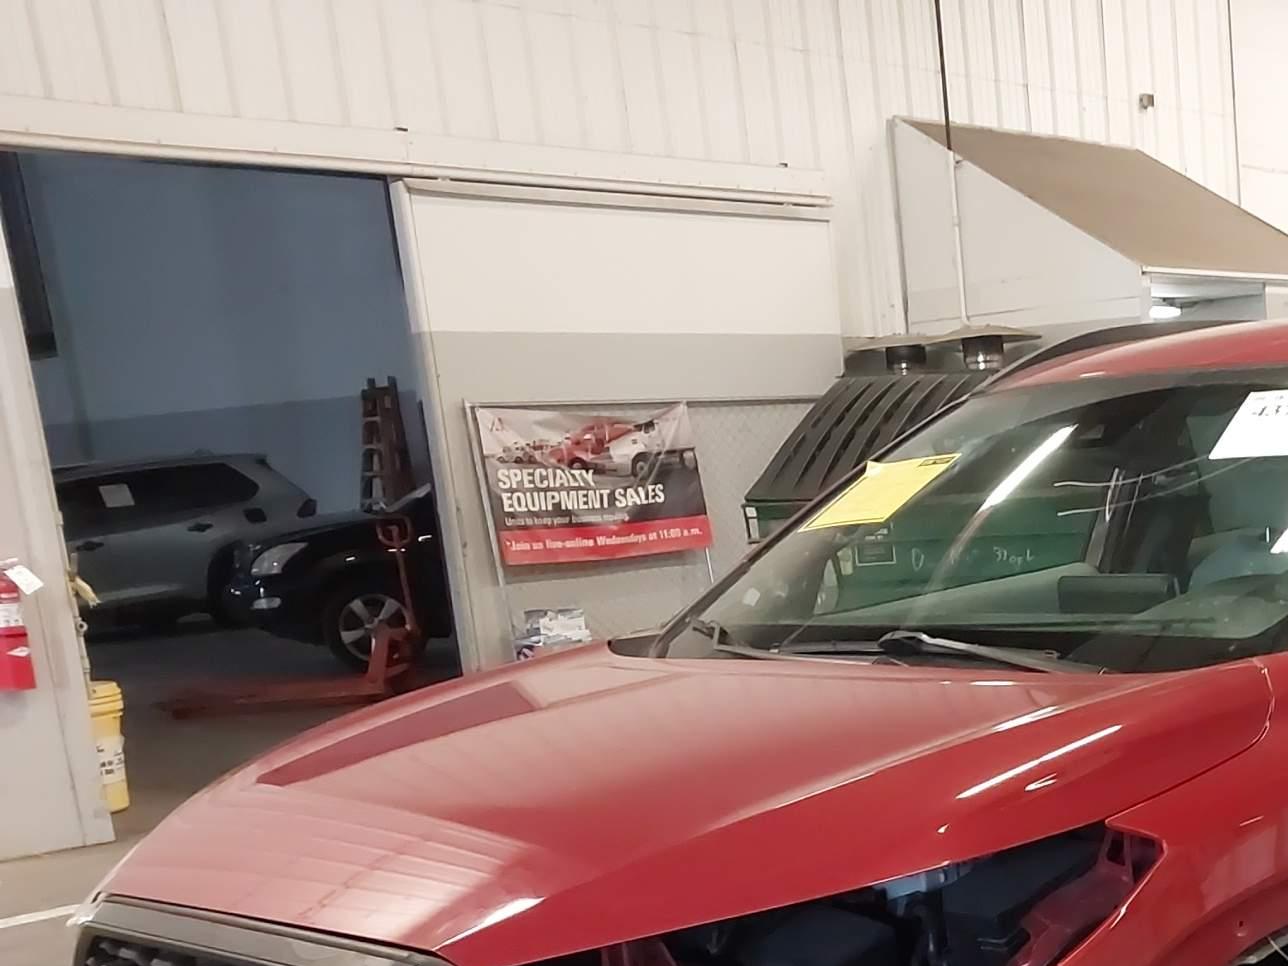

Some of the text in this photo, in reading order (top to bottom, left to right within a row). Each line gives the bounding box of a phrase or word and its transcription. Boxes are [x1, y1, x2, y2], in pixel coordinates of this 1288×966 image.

[497, 468, 595, 489] SPECIALTY
[501, 483, 665, 512] EQUIPMENT SALES
